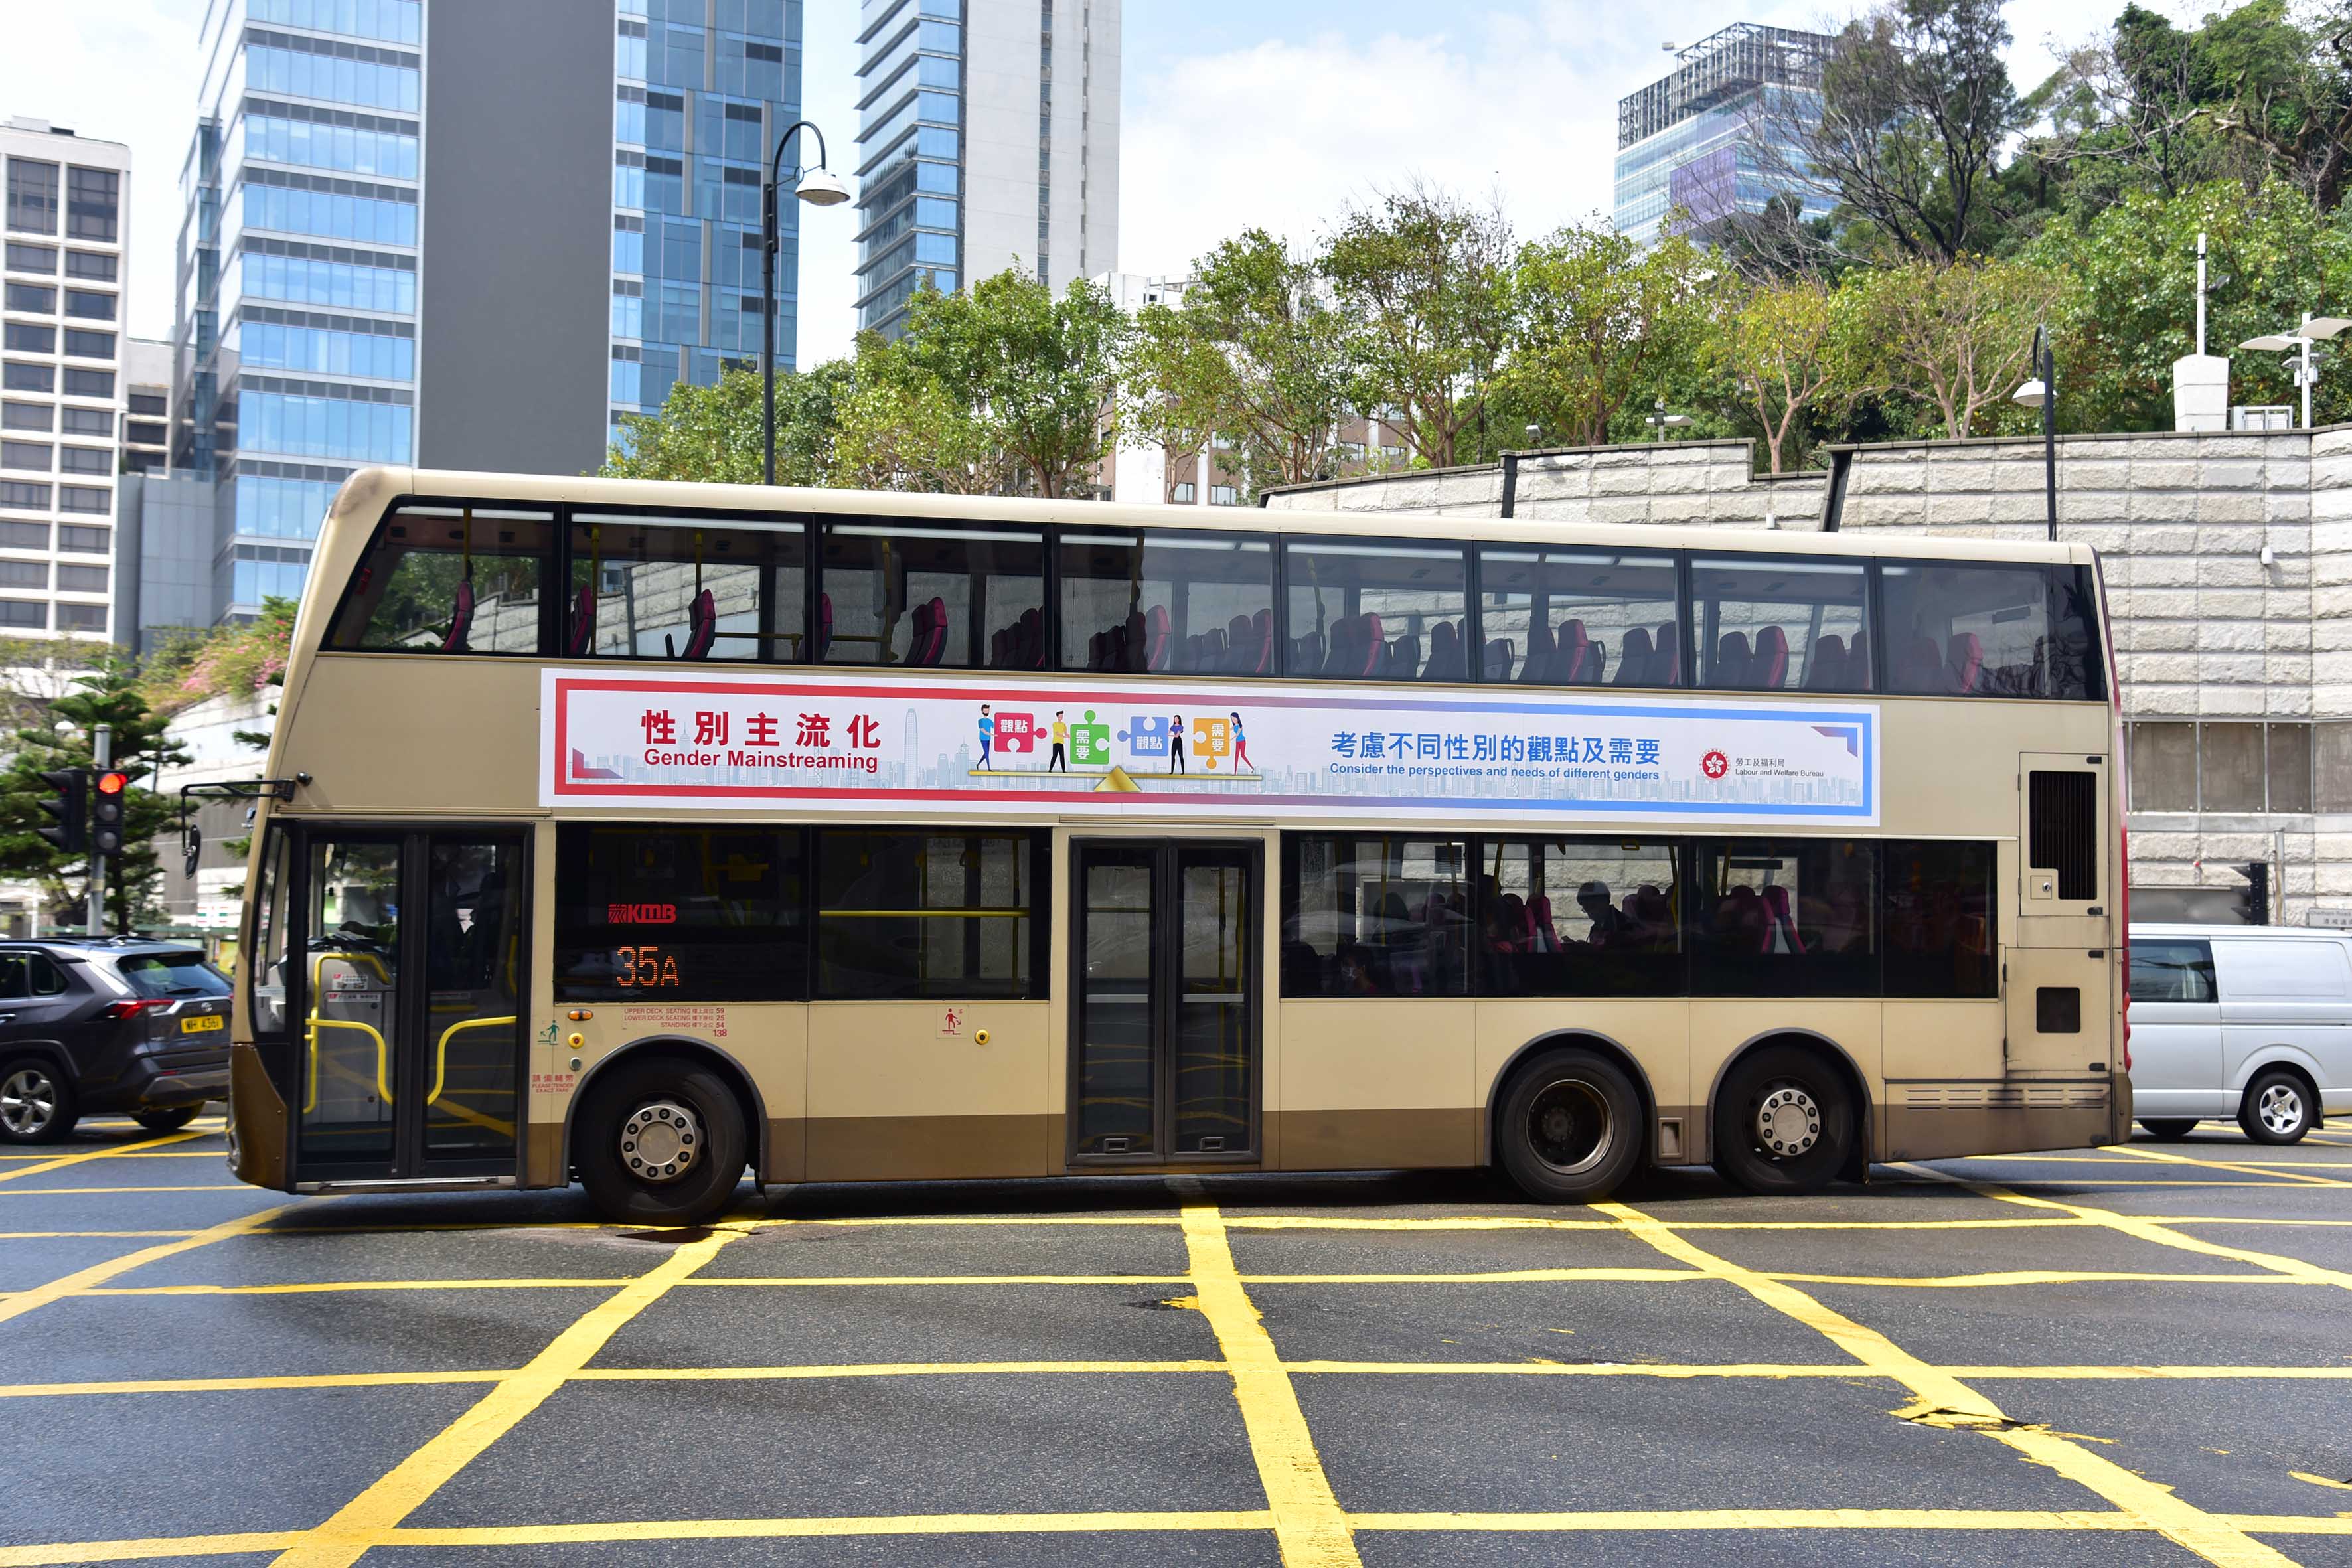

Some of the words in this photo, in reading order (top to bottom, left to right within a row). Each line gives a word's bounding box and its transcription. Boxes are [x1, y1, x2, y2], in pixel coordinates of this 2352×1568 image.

[641, 709, 881, 749] 性別主流化
[1000, 719, 1028, 734] 觀點
[1212, 723, 1225, 753] 需要
[1076, 729, 1090, 761] 需要
[1136, 736, 1163, 750] 觀點
[1330, 731, 1660, 765] 考慮不同性別的觀點及需要
[645, 748, 720, 766] Gender
[728, 751, 878, 773] Mainstreaming
[1330, 763, 1384, 775] Consider
[1387, 765, 1405, 775] the
[1409, 765, 1482, 778] perspectives
[1486, 767, 1507, 777] and
[1511, 767, 1545, 777] needs
[1549, 768, 1561, 777] of
[1563, 768, 1610, 779] different
[1614, 769, 1660, 781] genders
[1735, 758, 1785, 768] 勞工及福利局
[627, 904, 677, 923] KMB
[617, 947, 679, 986] 35A
